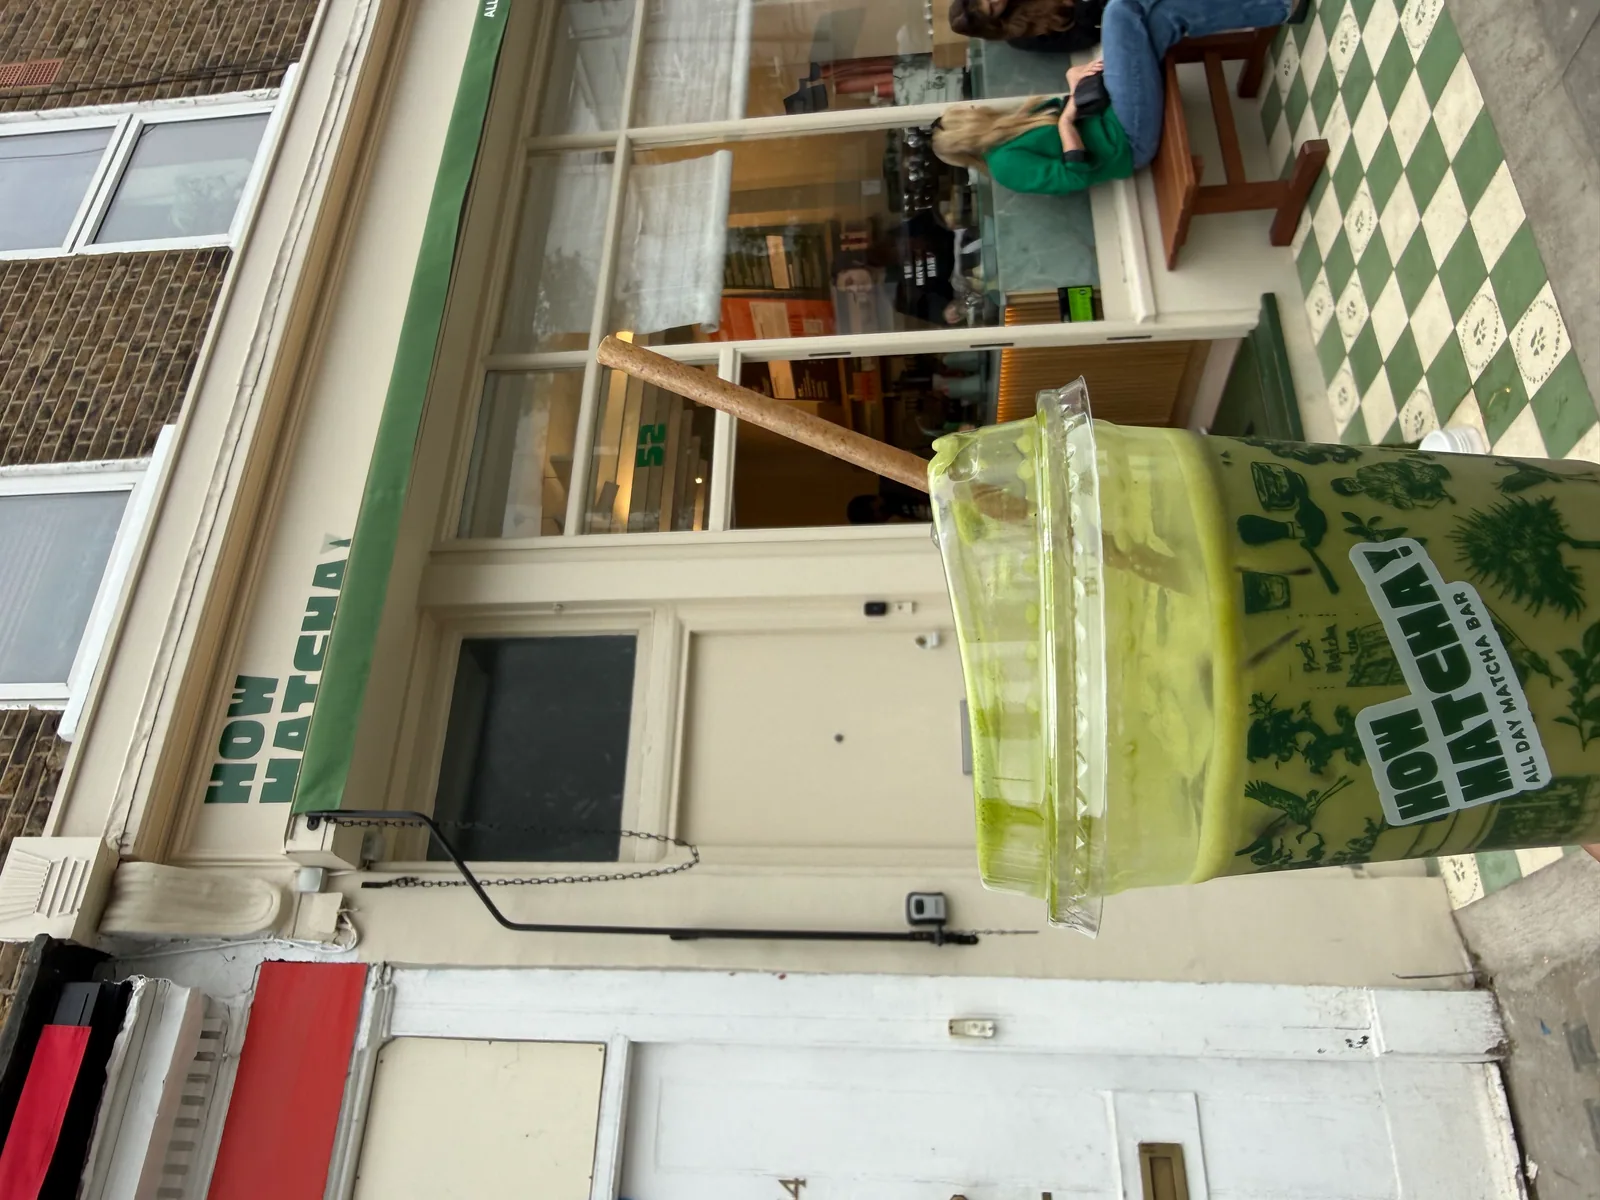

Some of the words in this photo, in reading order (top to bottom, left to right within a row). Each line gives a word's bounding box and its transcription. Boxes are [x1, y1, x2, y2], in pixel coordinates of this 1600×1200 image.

[636, 423, 666, 467] 52
[1453, 591, 1481, 631] BAR
[1474, 634, 1517, 714] MATCHA
[204, 675, 279, 804] HOW
[1506, 720, 1531, 752] DAY
[1369, 708, 1450, 820] HOW
[1525, 755, 1541, 784] ALL
[777, 1178, 806, 1200] 4
